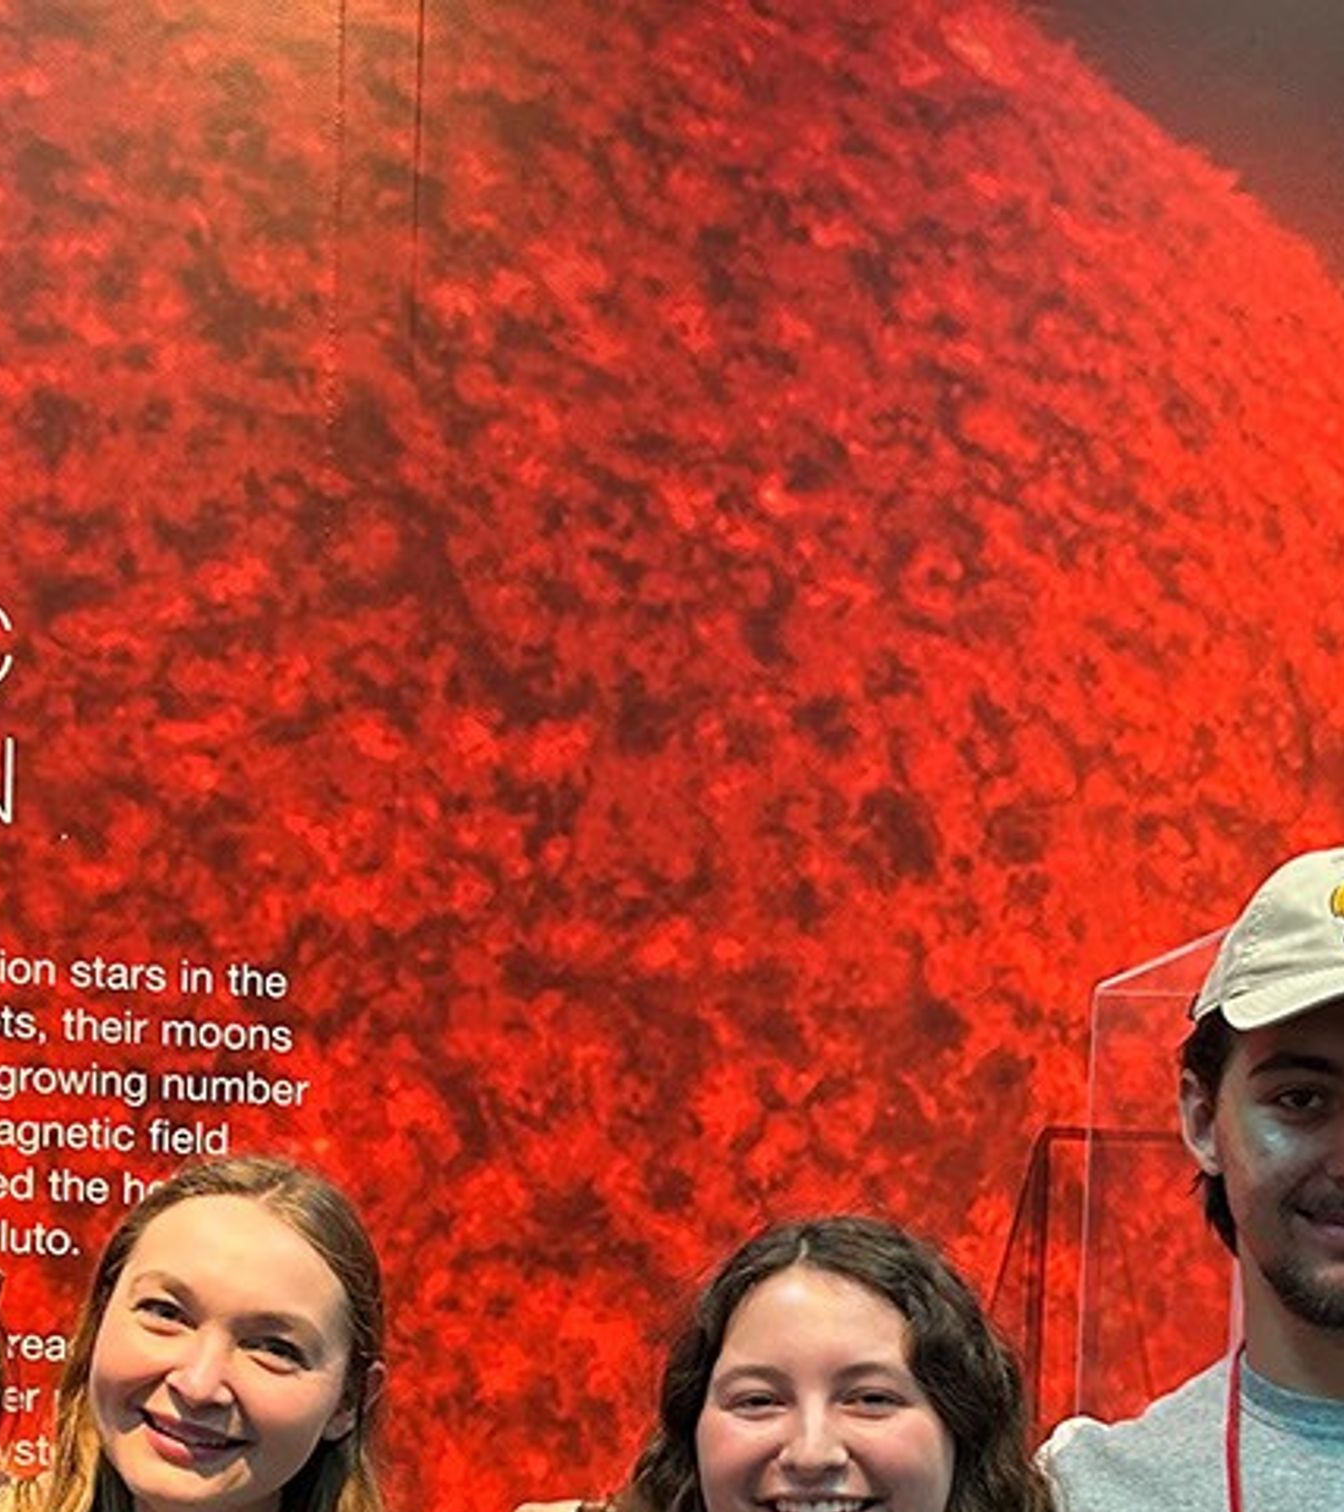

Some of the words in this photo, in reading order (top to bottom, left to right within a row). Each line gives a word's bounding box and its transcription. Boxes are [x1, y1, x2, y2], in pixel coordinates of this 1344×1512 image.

[71, 957, 166, 991] stars
[182, 960, 212, 993] in
[228, 964, 286, 998] the
[63, 1009, 147, 1043] their
[163, 1021, 291, 1052] moons
[163, 1071, 308, 1105] number
[149, 1119, 231, 1156] field
[49, 1169, 108, 1203] the
